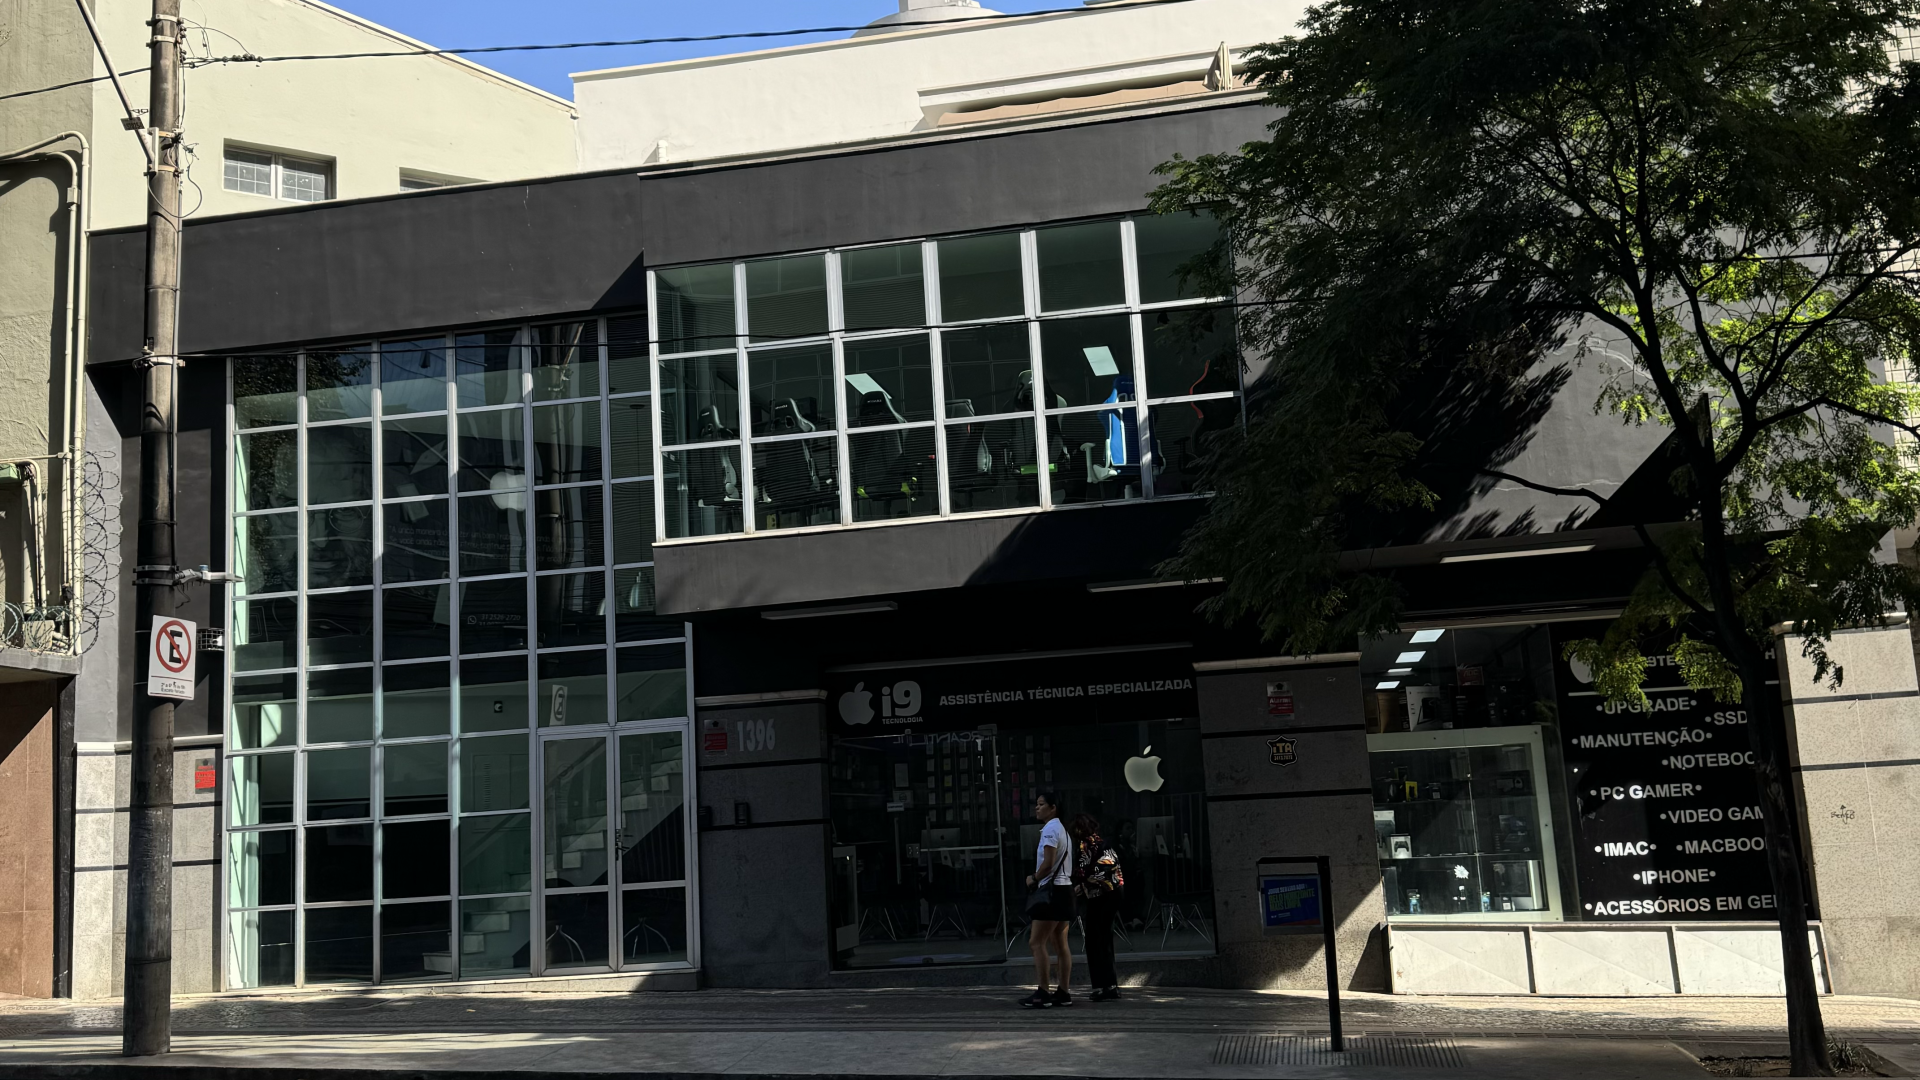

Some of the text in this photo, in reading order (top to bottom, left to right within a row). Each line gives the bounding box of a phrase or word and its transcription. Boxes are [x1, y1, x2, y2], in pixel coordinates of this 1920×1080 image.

[881, 680, 922, 717] i9
[939, 678, 1193, 706] ASSISTÊNCIA TÉCNICA ESPECIALIZADA
[1604, 696, 1691, 715] UPGRADE
[882, 716, 924, 725] TECNOLOGIA
[736, 718, 776, 752] 1396
[1580, 726, 1706, 749] MANUTENÇÃO
[1669, 751, 1755, 770] NOTEBOO
[1601, 782, 1695, 801] PC GAMER
[1667, 807, 1723, 824] VIDEO
[1603, 841, 1649, 857] IMAC
[1684, 836, 1768, 855] MACBOO
[1641, 868, 1710, 885] IPHONE
[1594, 896, 1712, 916] ACESSÓRIOS
[1716, 896, 1743, 911] EM
